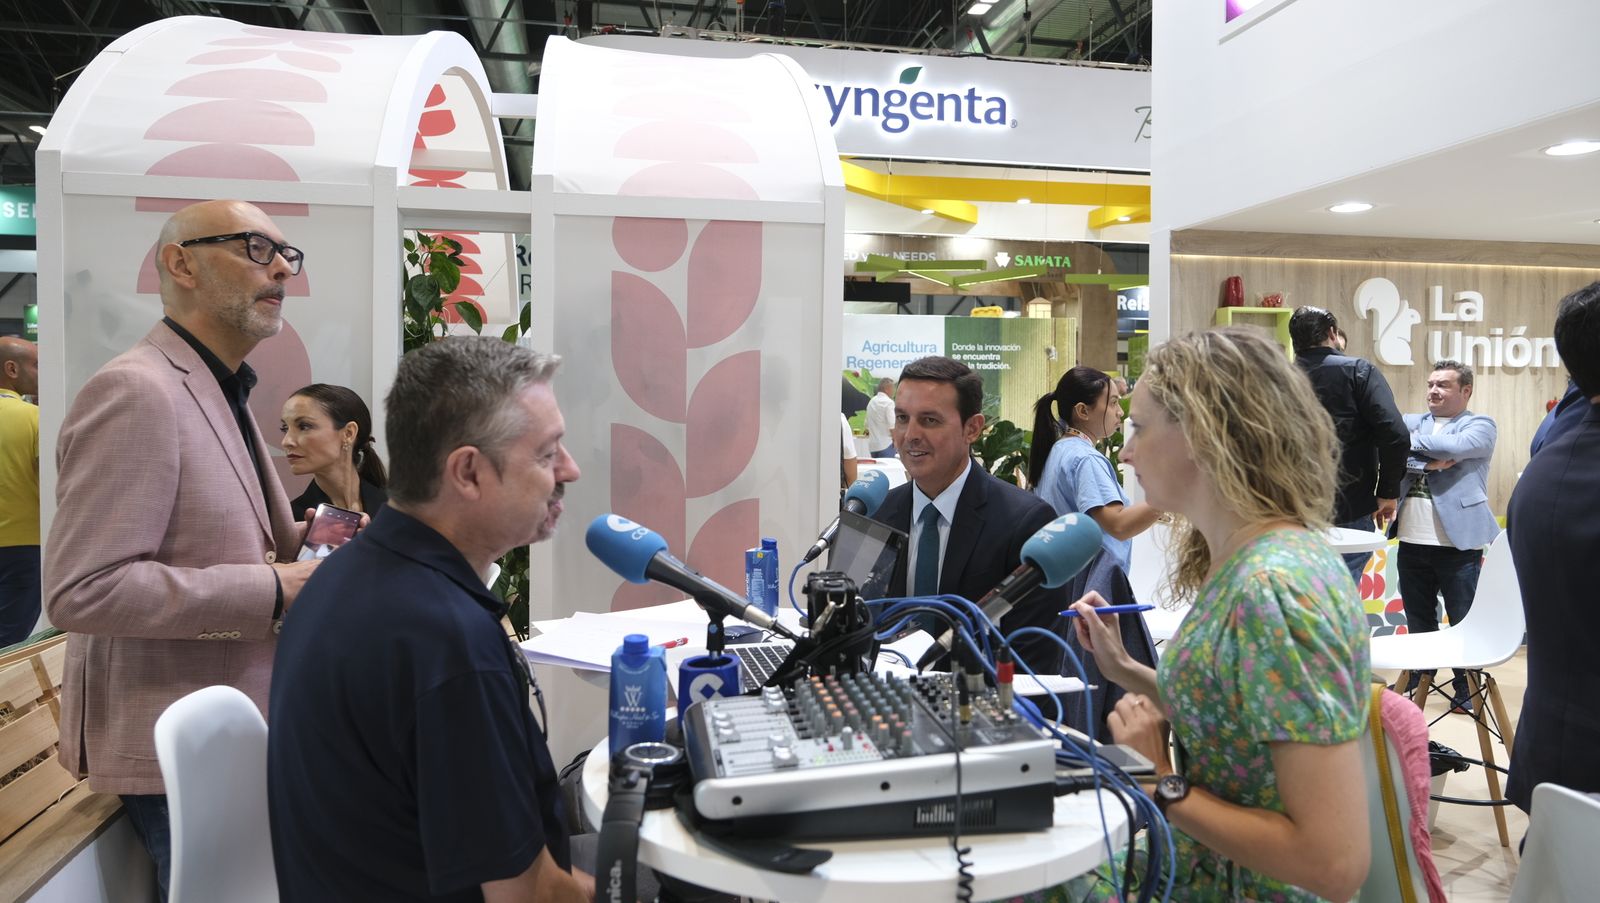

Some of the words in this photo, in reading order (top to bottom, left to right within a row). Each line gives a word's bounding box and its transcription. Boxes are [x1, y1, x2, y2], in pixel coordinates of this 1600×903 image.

[893, 251, 936, 261] NEEDS
[1014, 255, 1071, 268] SAKATA
[1429, 285, 1484, 321] La
[862, 340, 937, 355] Agricultura
[952, 343, 976, 351] Donde
[977, 343, 984, 351] la
[985, 343, 1021, 351] innovación
[1428, 326, 1560, 367] Unión
[963, 352, 1000, 360] encuentra
[968, 361, 975, 369] la
